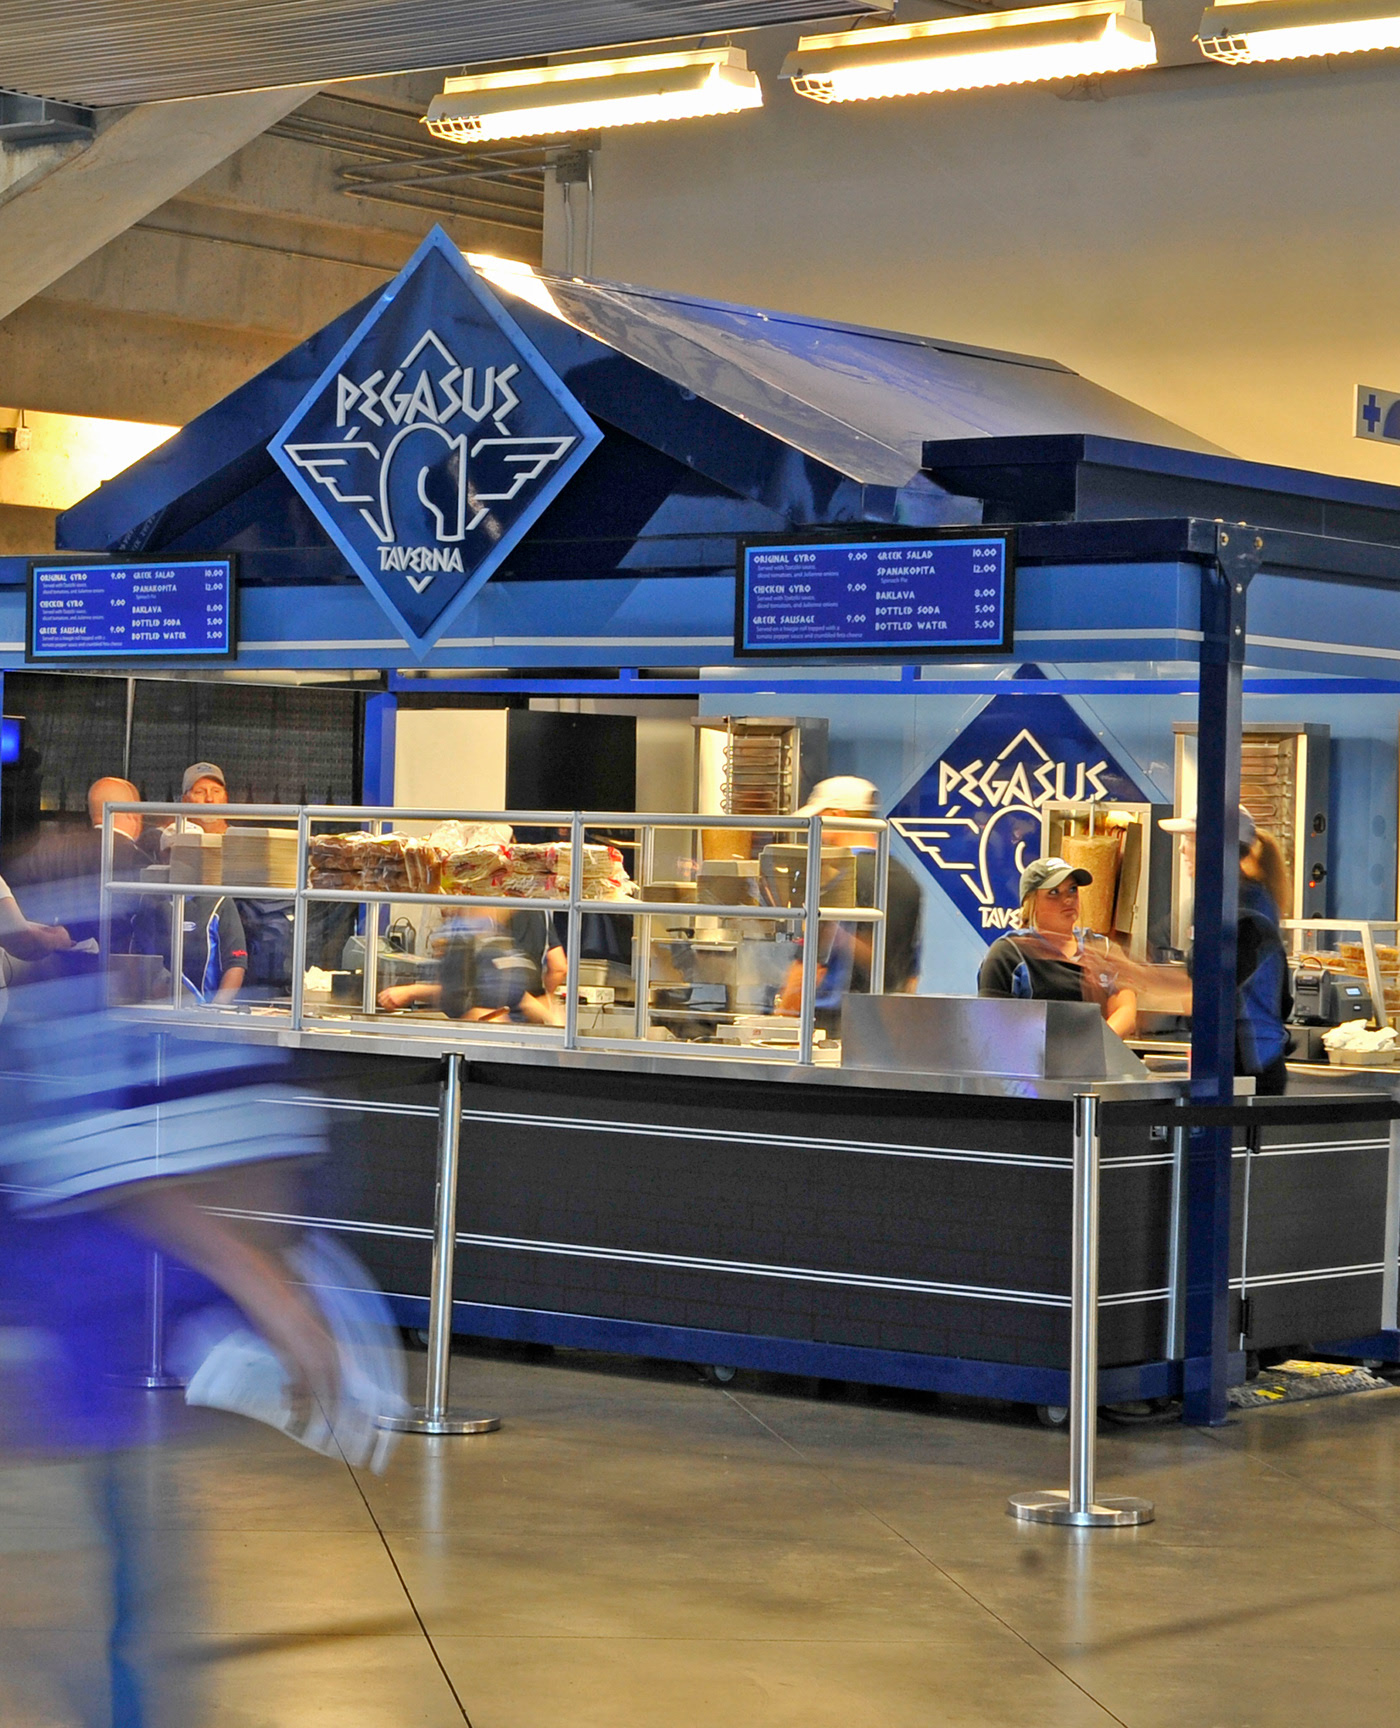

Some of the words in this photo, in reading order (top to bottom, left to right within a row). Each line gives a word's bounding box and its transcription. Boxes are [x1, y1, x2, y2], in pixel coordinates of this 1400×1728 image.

[336, 362, 521, 428] PEGASUS
[376, 546, 465, 574] TAVERNA
[753, 555, 789, 564] ORIGINAL
[793, 554, 816, 563] GYRO
[848, 552, 868, 561] 9.00
[877, 551, 903, 561] GREEK
[906, 550, 934, 560] SALAD
[972, 548, 997, 558] 10.00
[154, 570, 175, 579] SALAD
[876, 566, 936, 576] SPANAKOPITA
[972, 564, 997, 573] 12.00
[753, 585, 785, 594] CHICKEN
[788, 584, 812, 594] GYRO
[847, 583, 867, 592] 9.00
[875, 591, 916, 600] BAKLAVA
[974, 588, 996, 598] 8.00
[875, 606, 913, 616] BOTTLED
[917, 605, 941, 615] SODA
[974, 604, 996, 614] 5.00
[163, 618, 181, 627] SODA
[752, 615, 777, 625] GREEK
[780, 615, 815, 624] SAUSAGE
[846, 614, 867, 624] 9.00
[874, 621, 913, 631] BOTTLED
[917, 620, 948, 630] WATER
[974, 620, 996, 629] 5.00
[163, 631, 187, 640] WATER
[938, 759, 1109, 808] PEGASUS
[978, 906, 1023, 931] TAVE
